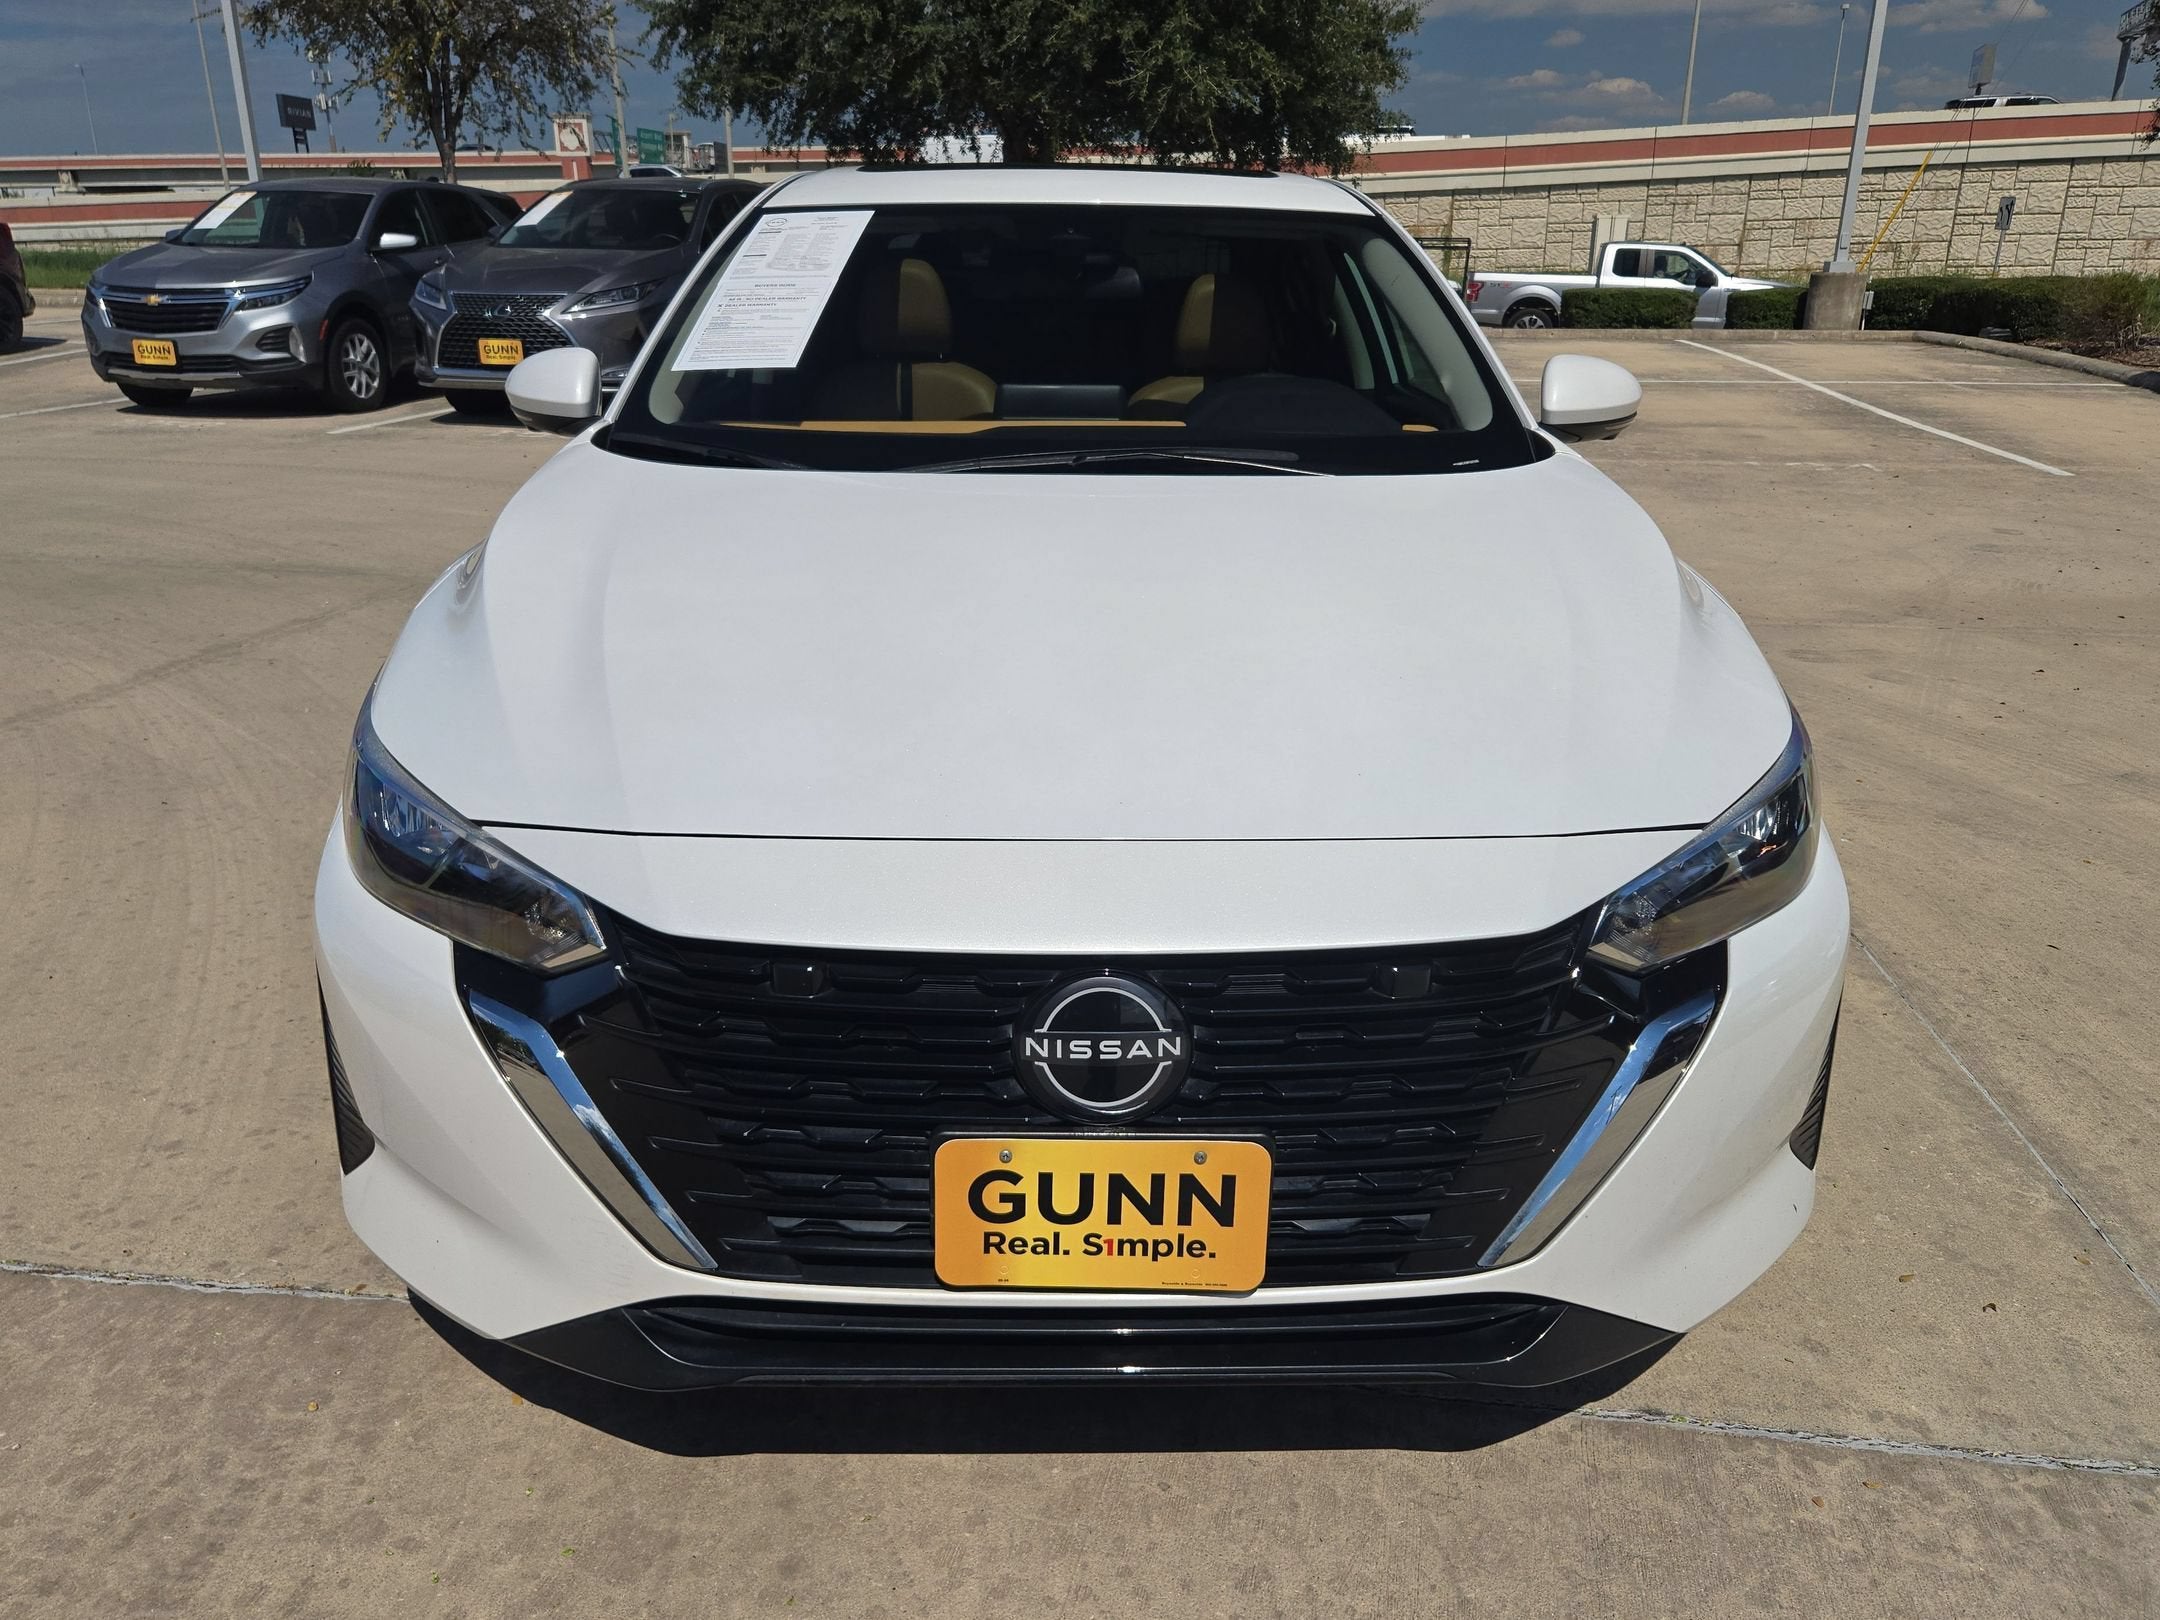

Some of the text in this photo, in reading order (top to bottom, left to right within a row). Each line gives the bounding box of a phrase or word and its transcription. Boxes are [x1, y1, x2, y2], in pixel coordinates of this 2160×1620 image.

[138, 345, 171, 355] GUNN
[483, 344, 519, 355] GUNN
[1025, 1036, 1182, 1060] NISSAN
[967, 1168, 1237, 1227] GUNN
[983, 1231, 1070, 1256] Real.
